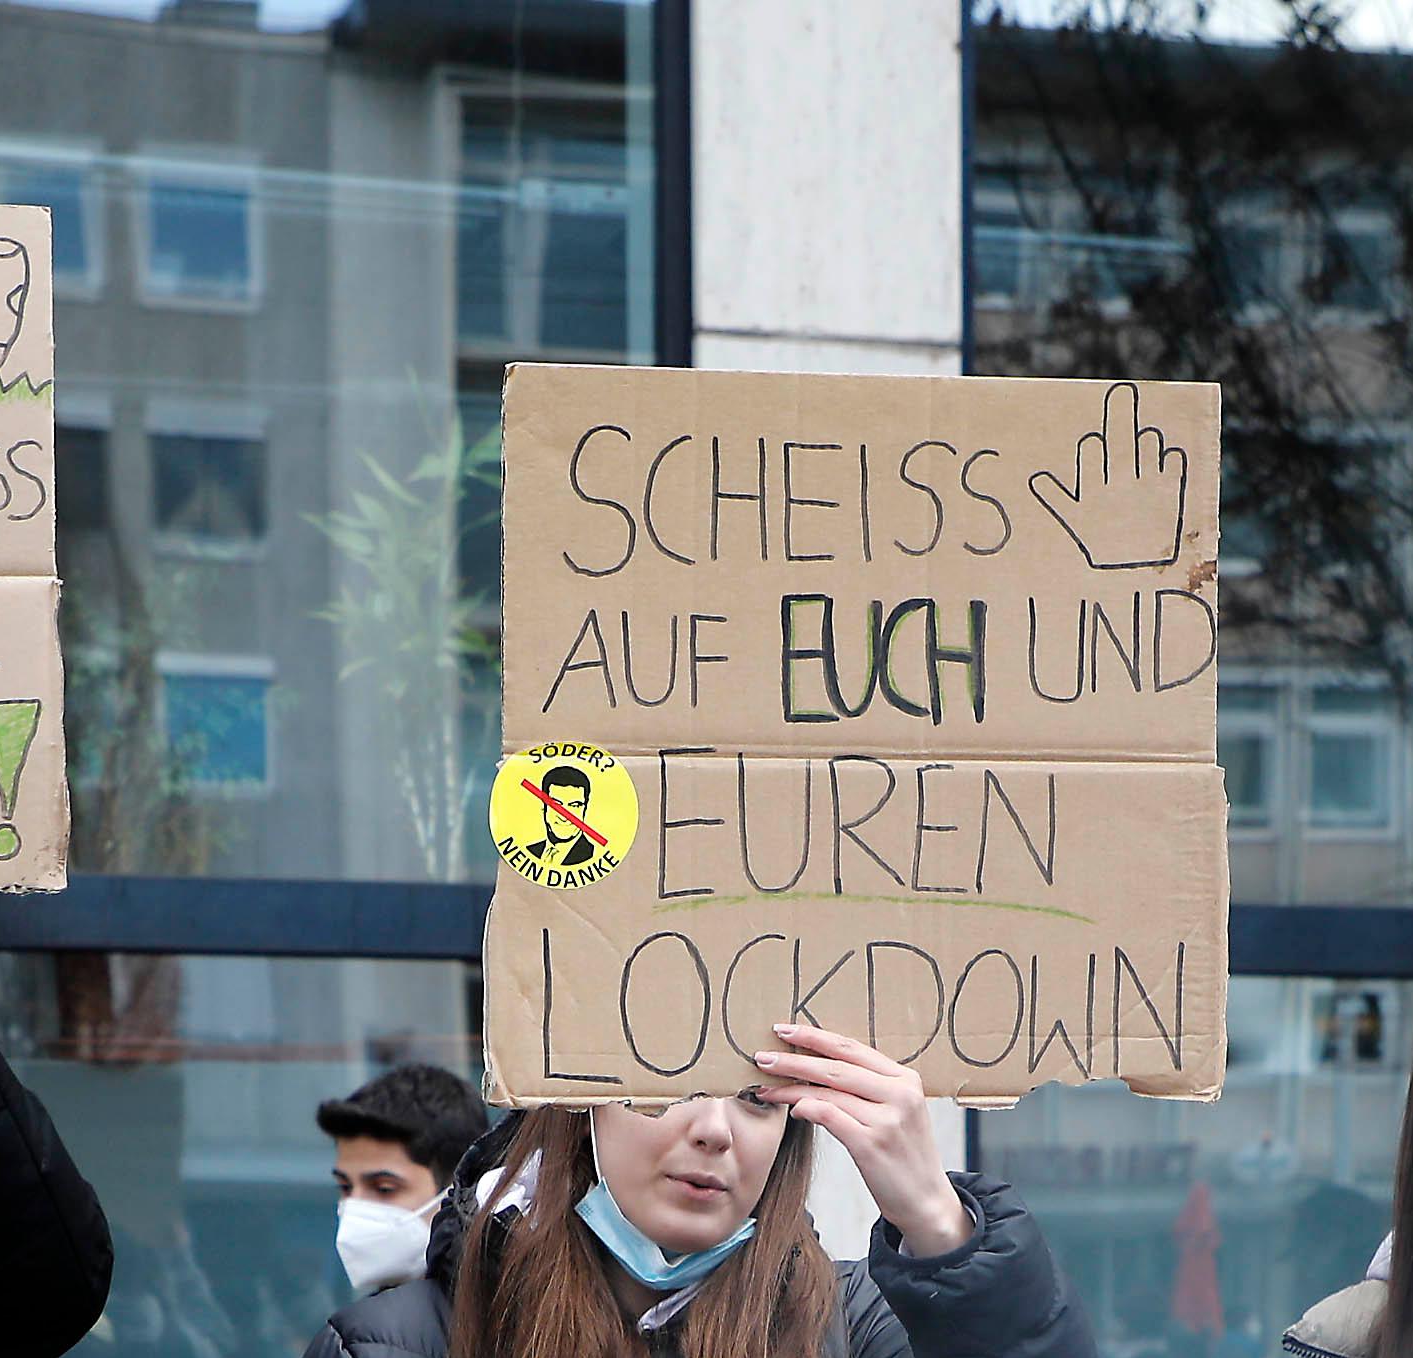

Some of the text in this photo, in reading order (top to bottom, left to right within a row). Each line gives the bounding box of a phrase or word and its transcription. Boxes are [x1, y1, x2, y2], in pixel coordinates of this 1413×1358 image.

[562, 424, 1013, 578] SCHEISS
[542, 589, 1217, 726] AUF EUCH UND
[529, 742, 615, 773] SÖDER?
[658, 746, 1058, 901] EUREN
[498, 836, 620, 889] NEIN DANKE
[541, 927, 1186, 1085] LOCKDOWN
